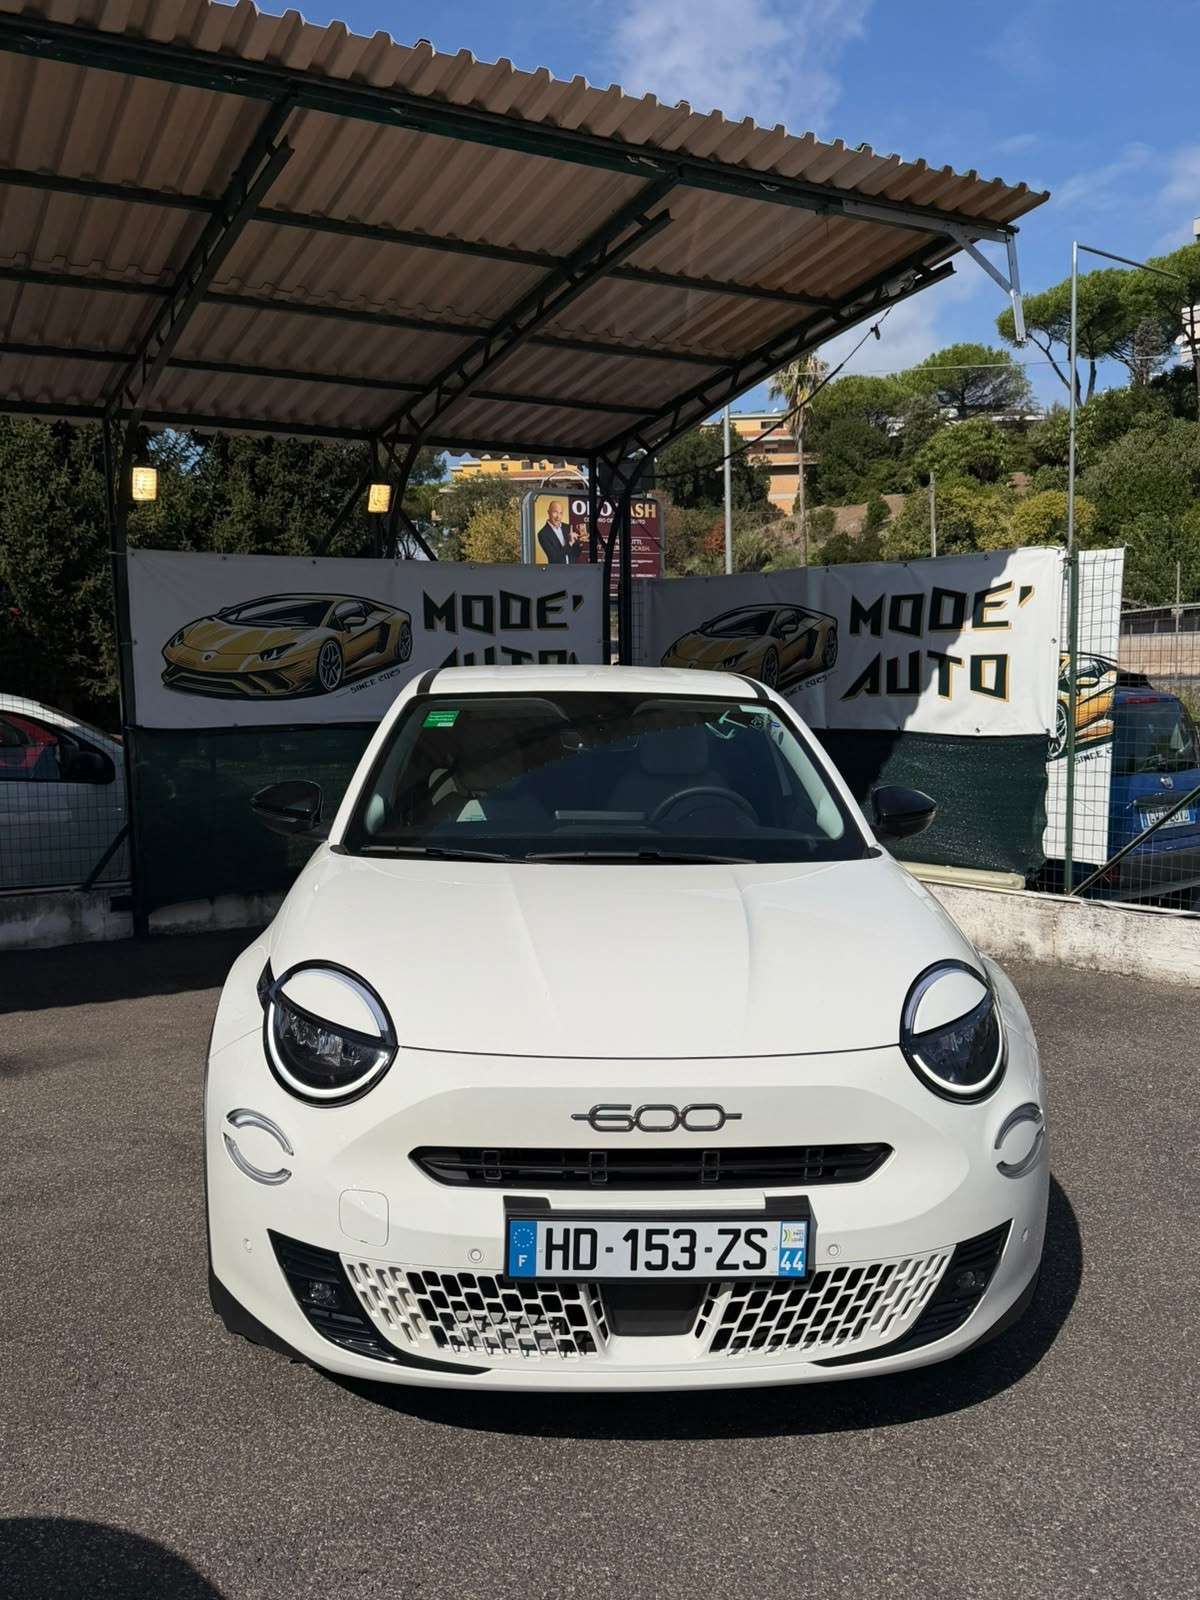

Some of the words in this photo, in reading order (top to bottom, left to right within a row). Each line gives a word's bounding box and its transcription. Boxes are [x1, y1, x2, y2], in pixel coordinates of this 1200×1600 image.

[840, 649, 1010, 702] AUTO
[586, 1103, 728, 1132] 600
[517, 1254, 528, 1267] F
[780, 1250, 804, 1271] 44
